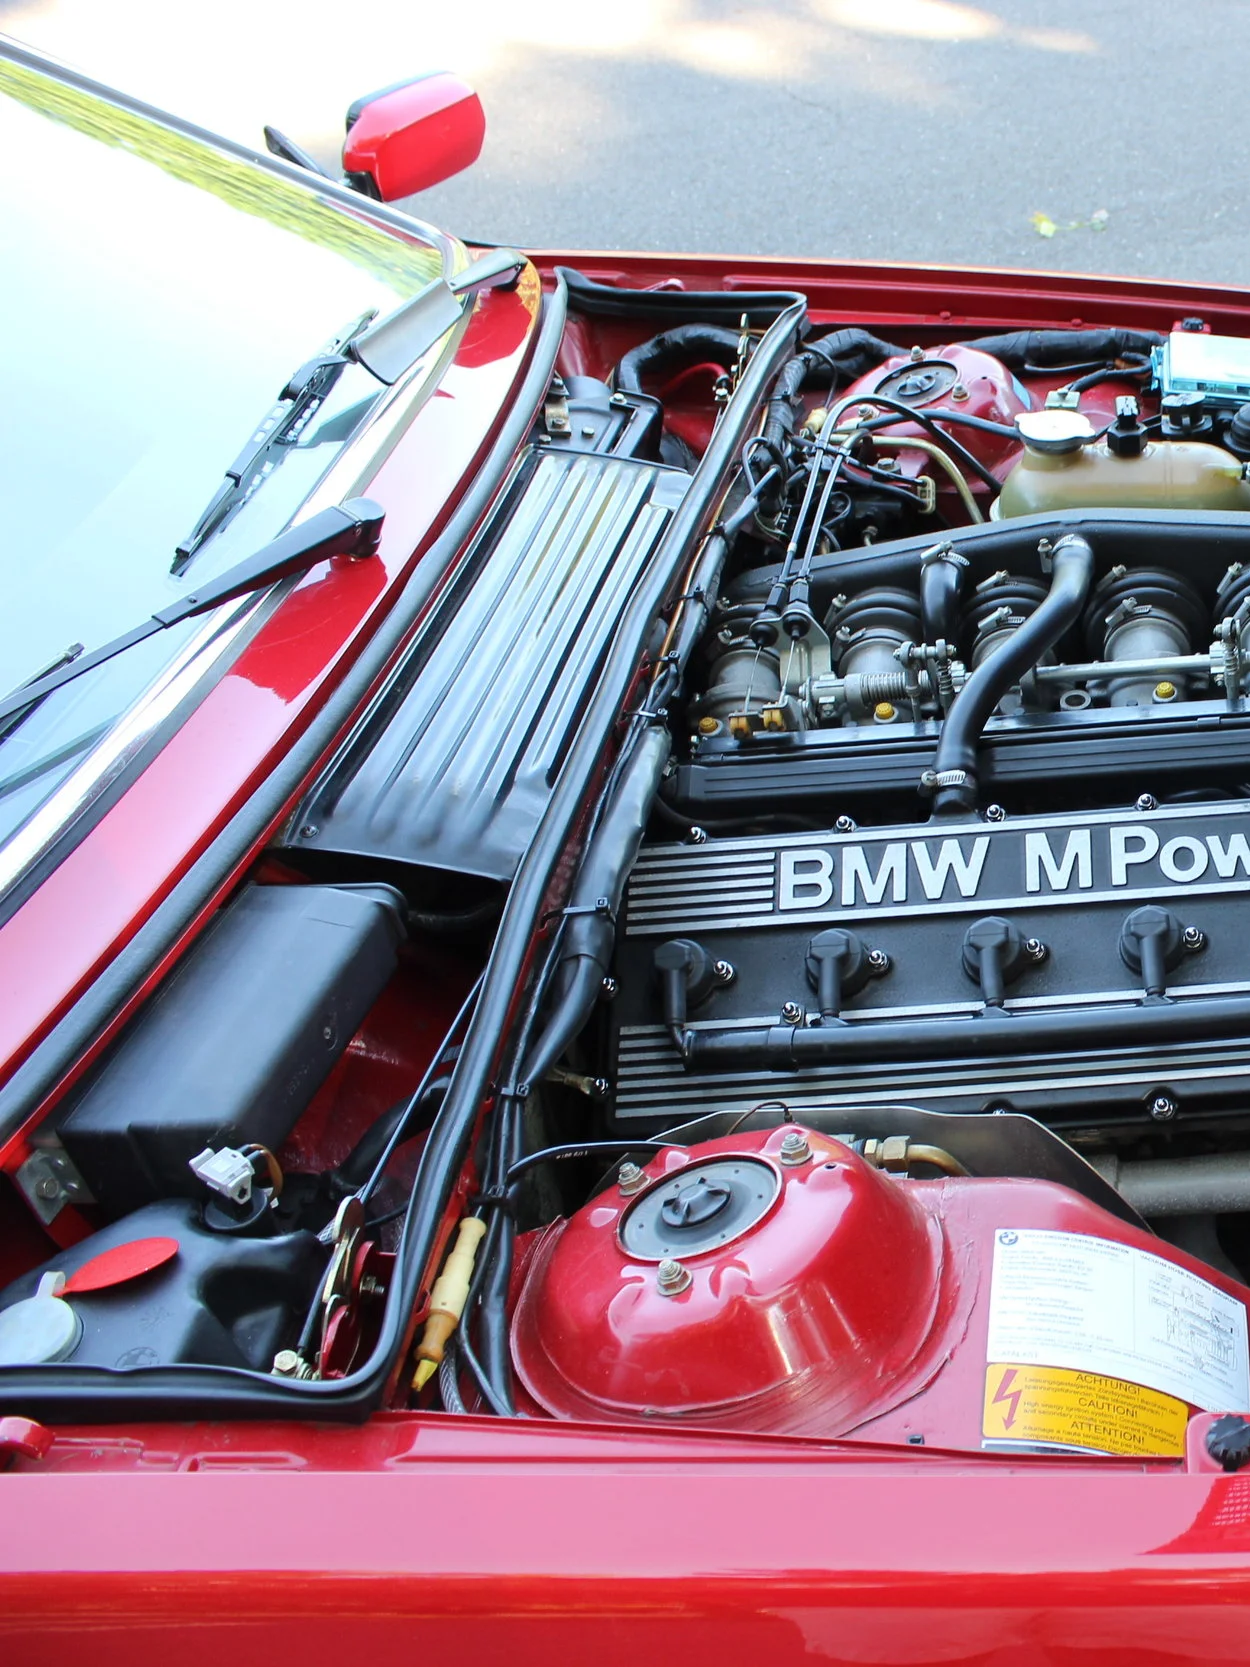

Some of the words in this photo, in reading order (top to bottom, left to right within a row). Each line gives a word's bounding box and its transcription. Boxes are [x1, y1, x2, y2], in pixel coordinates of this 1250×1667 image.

[778, 836, 991, 910] BMW
[1075, 1373, 1141, 1396] ACHTUNG!
[1078, 1397, 1138, 1419] CAUTION!
[1070, 1420, 1145, 1445] ATTENTION!
